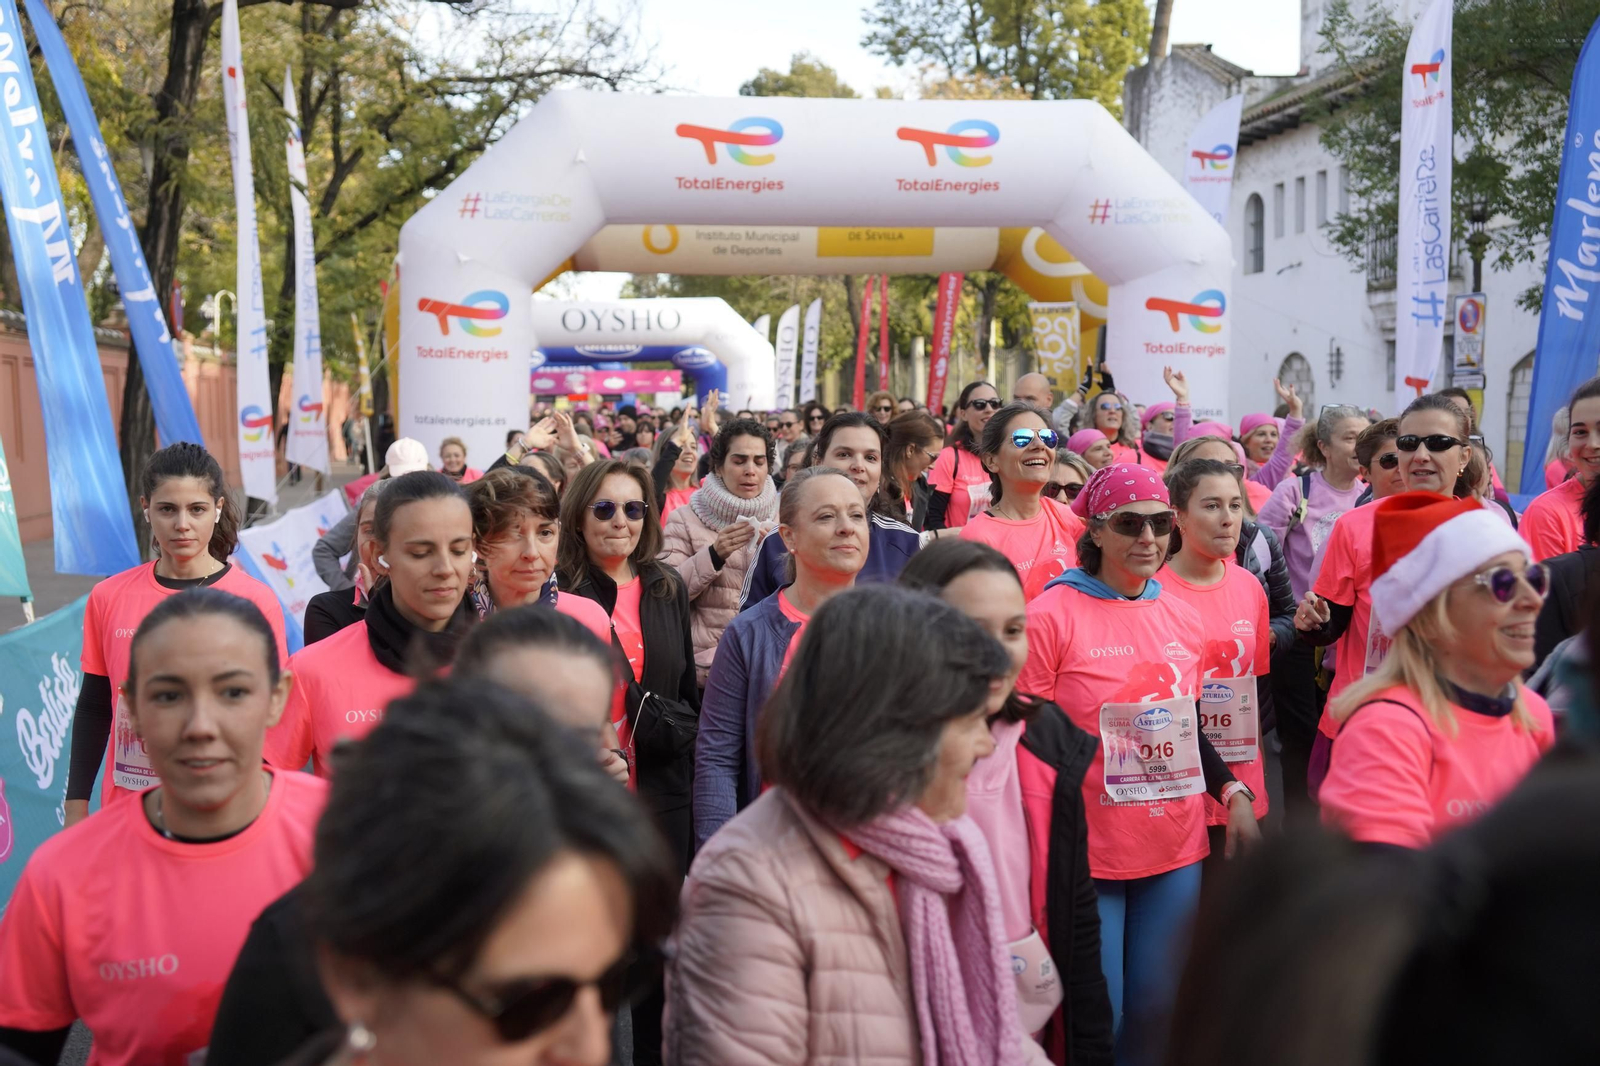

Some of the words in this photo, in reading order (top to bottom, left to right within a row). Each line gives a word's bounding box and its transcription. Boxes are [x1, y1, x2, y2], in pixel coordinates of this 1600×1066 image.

[675, 175, 784, 194] TotalEnergies
[896, 178, 1000, 195] TotalEnergies
[695, 229, 743, 242] Instituto
[744, 230, 800, 244] Municipal
[847, 231, 862, 241] DE
[712, 244, 728, 255] de
[730, 244, 783, 257] Deportes
[561, 307, 682, 333] OYSHO
[416, 345, 509, 363] TotalEnergies
[1143, 342, 1226, 358] TotalEnergies
[414, 414, 507, 428] totalenergies.es
[115, 628, 136, 639] OYS
[1090, 645, 1134, 658] OYSHO
[1137, 716, 1171, 727] ASTURIANA
[1205, 732, 1222, 740] 5996
[1140, 741, 1174, 760] 016
[124, 766, 142, 774] CARRERA
[1149, 765, 1167, 774] 5999
[121, 775, 149, 787] OYSHO
[1120, 775, 1141, 783] CARRERA
[1173, 770, 1188, 778] SEVILLA
[1115, 786, 1147, 796] OYSHO
[1165, 783, 1192, 792] Santander
[1148, 806, 1165, 817] 2025
[1446, 799, 1488, 818] OYS
[99, 953, 180, 982] OYSHO
